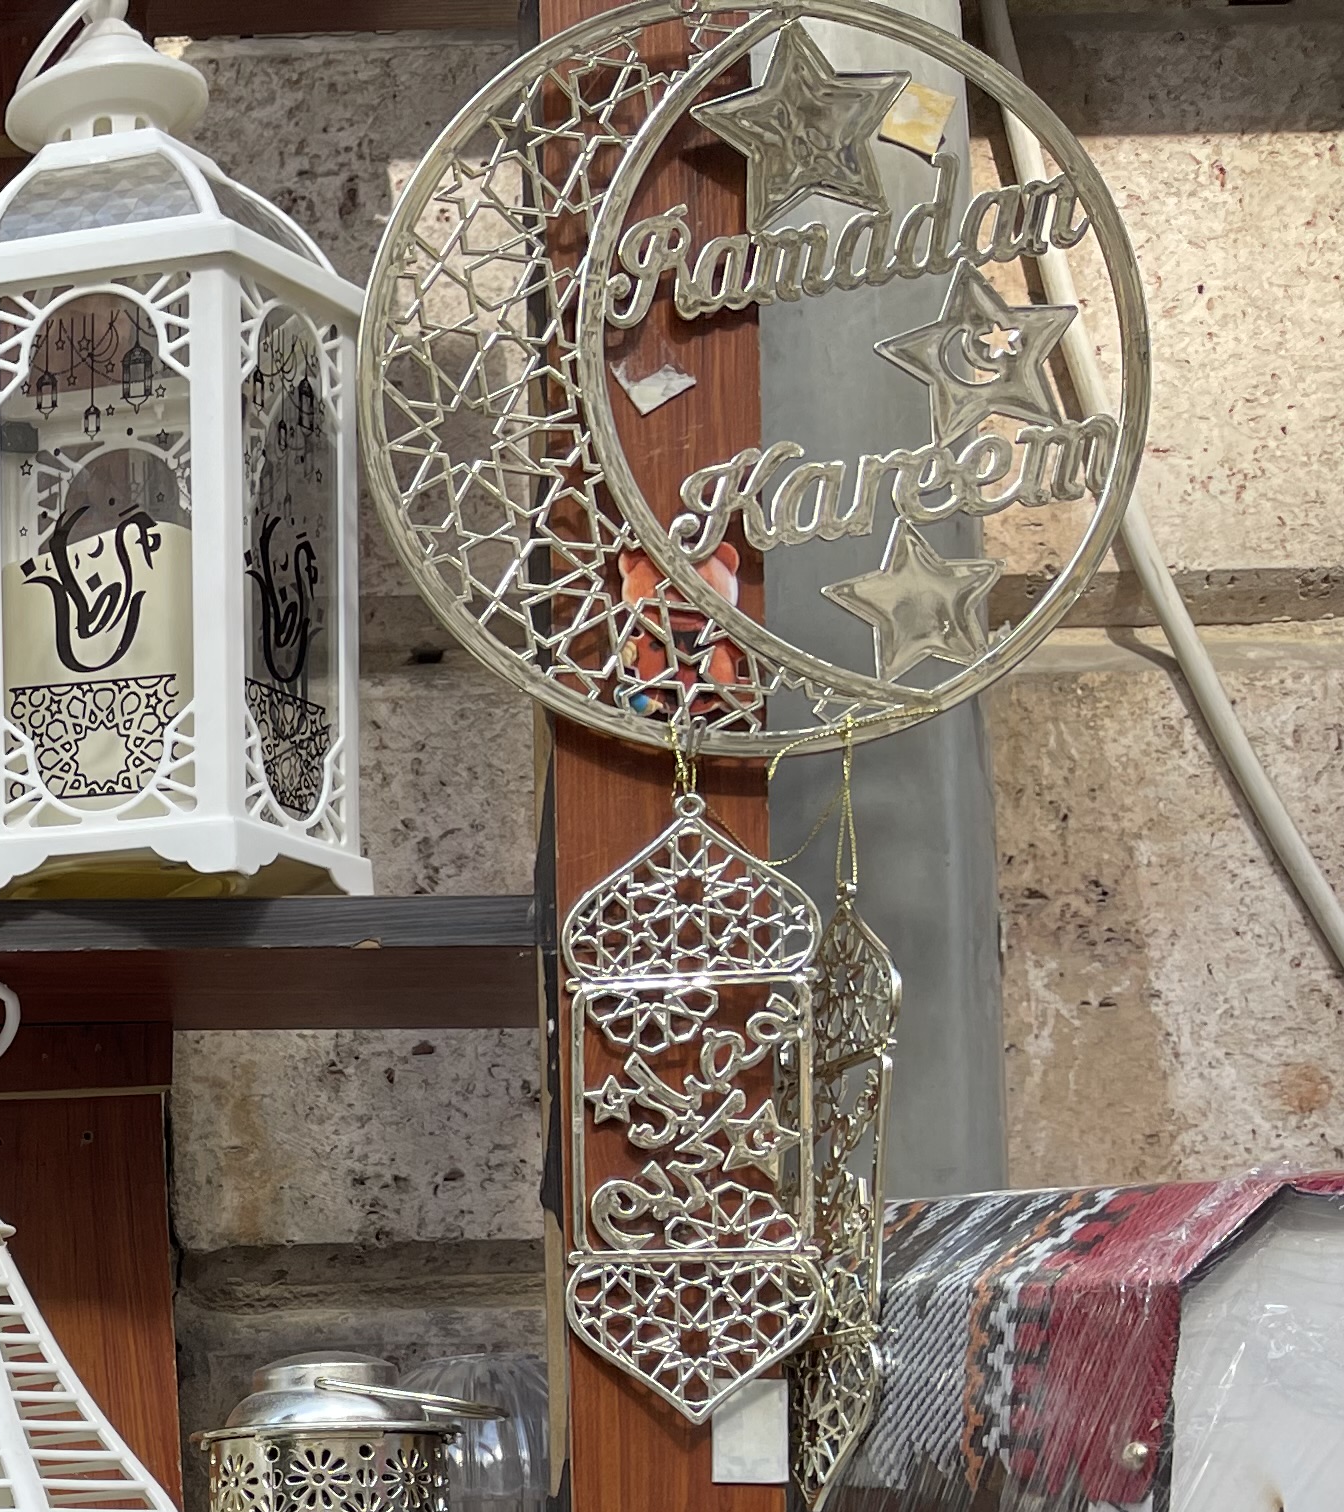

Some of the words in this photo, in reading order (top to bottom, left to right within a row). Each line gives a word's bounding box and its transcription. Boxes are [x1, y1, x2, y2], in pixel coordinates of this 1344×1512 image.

[605, 152, 1091, 330] Ramadan
[668, 411, 1123, 566] Kareem
[20, 504, 162, 673] رمضان
